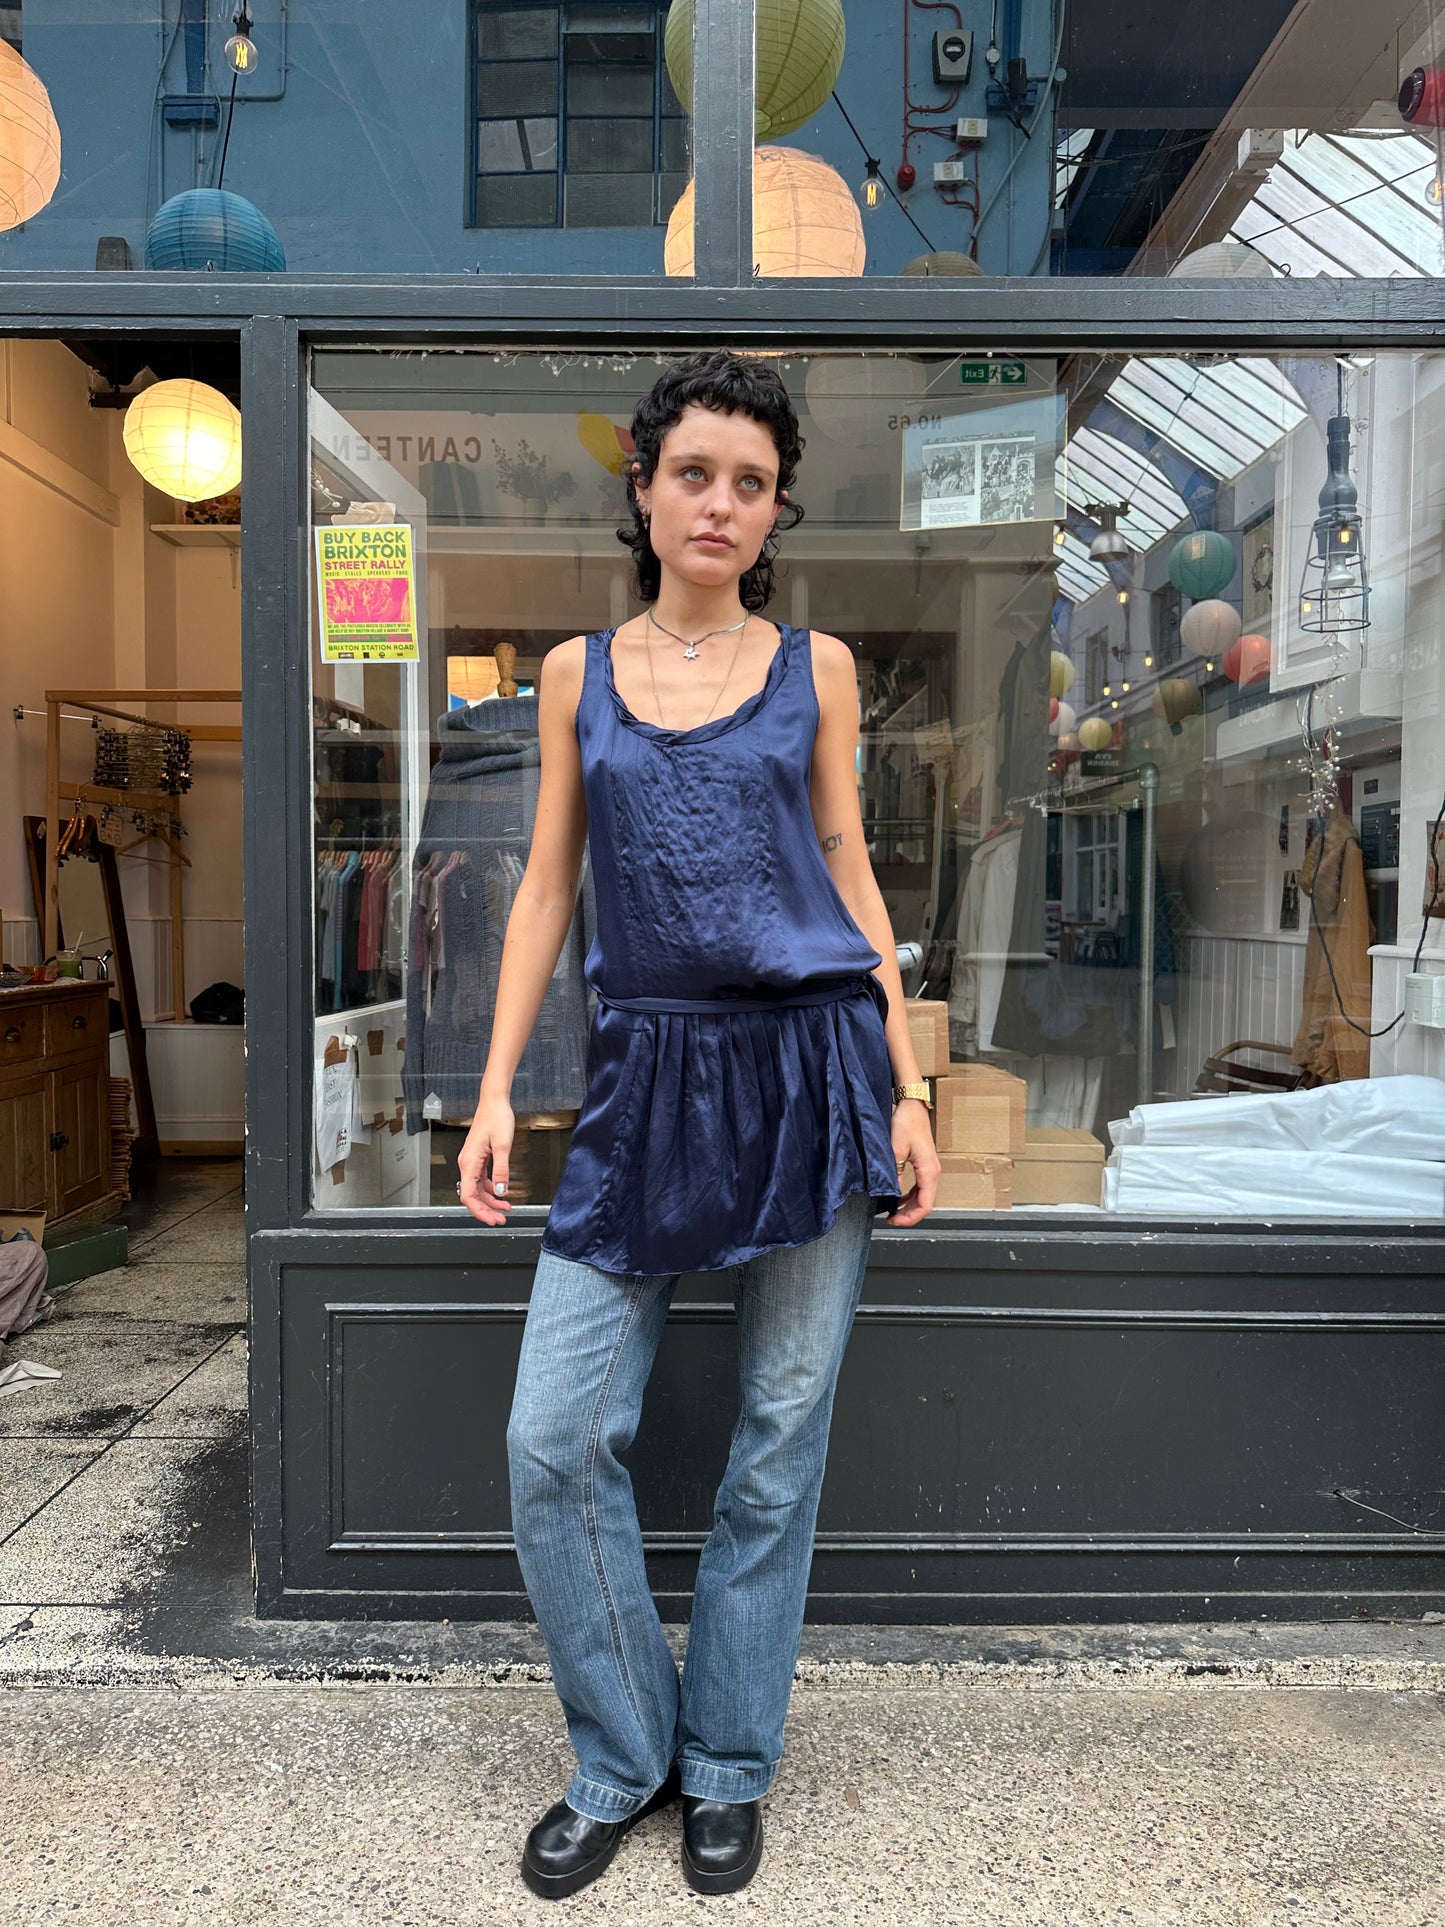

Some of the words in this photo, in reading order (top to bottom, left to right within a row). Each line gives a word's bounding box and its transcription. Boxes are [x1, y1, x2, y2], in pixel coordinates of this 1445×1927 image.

[324, 532, 356, 544] BUY
[361, 531, 405, 543] BACK
[324, 543, 407, 560] BRIXTON
[324, 560, 367, 571] STREET
[370, 560, 406, 569] RALLY
